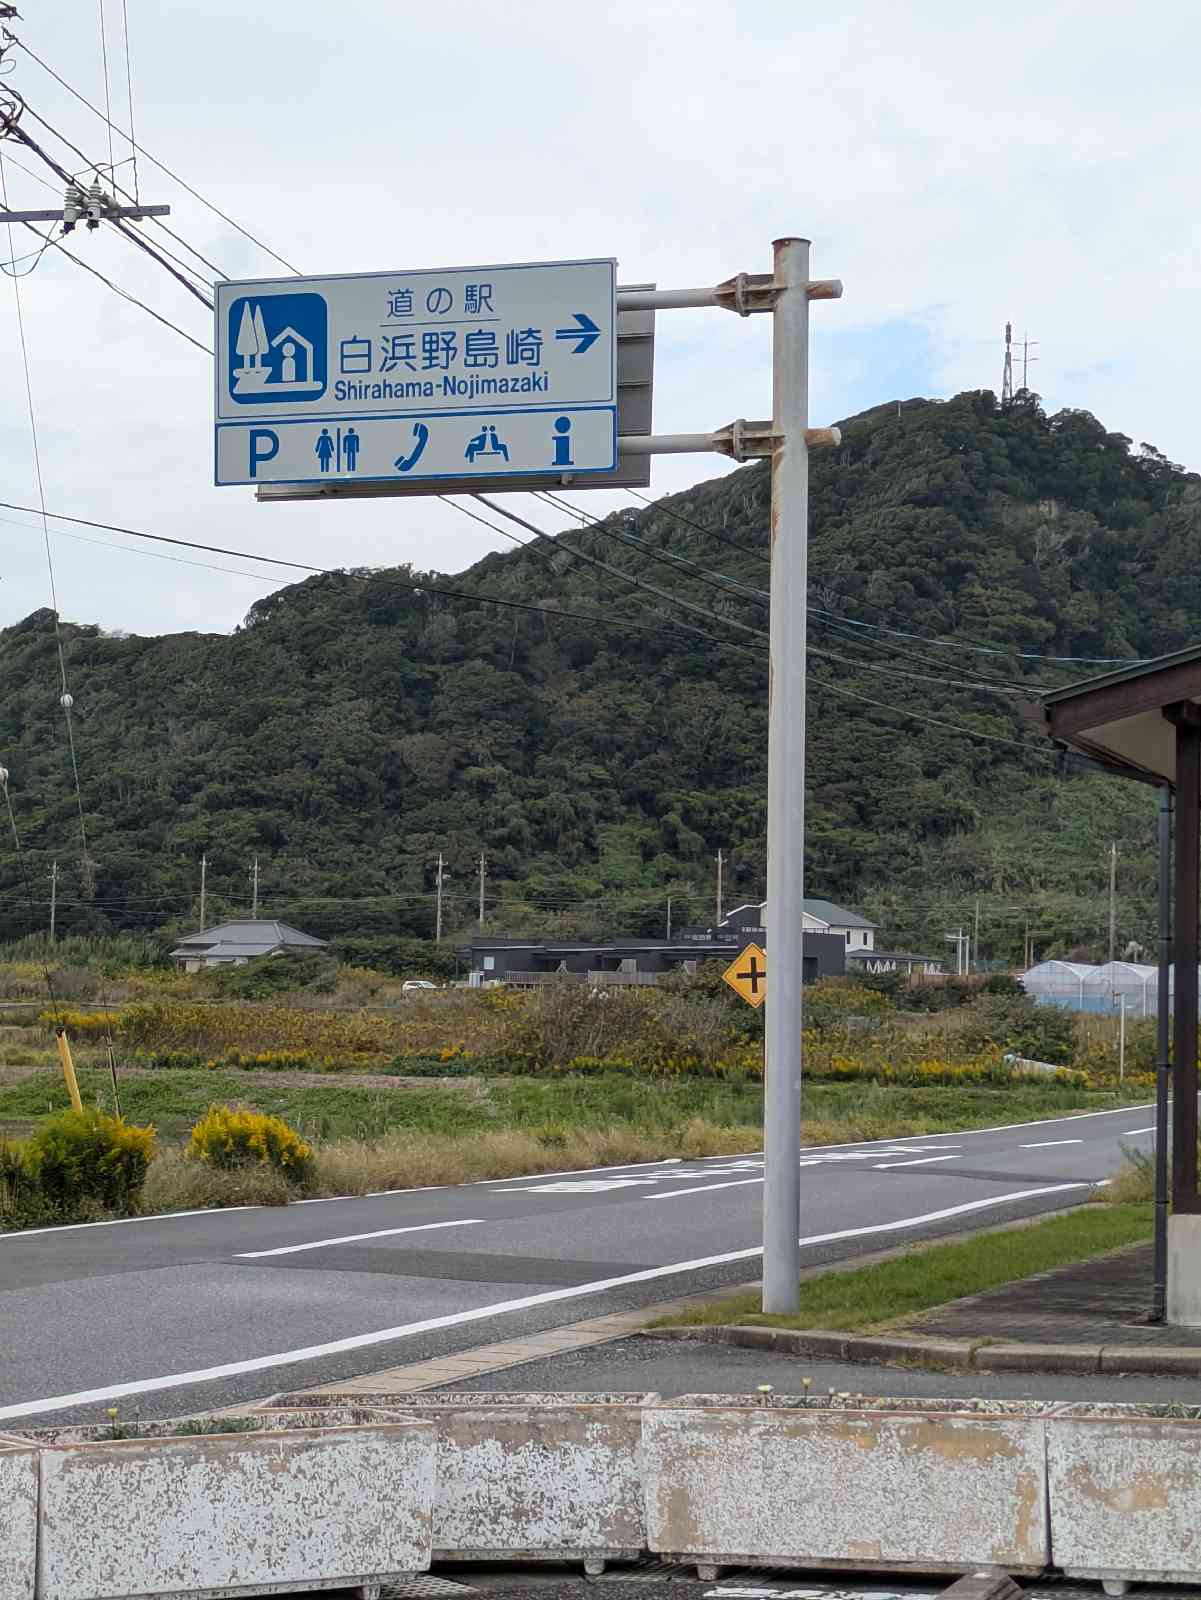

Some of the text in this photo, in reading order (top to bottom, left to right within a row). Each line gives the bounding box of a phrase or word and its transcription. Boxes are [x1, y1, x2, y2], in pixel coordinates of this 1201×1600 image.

[386, 284, 495, 318] 道の駅
[338, 328, 544, 373] 白浜野島崎
[335, 371, 549, 401] Shirahama-Nojimazaki
[249, 429, 279, 478] P
